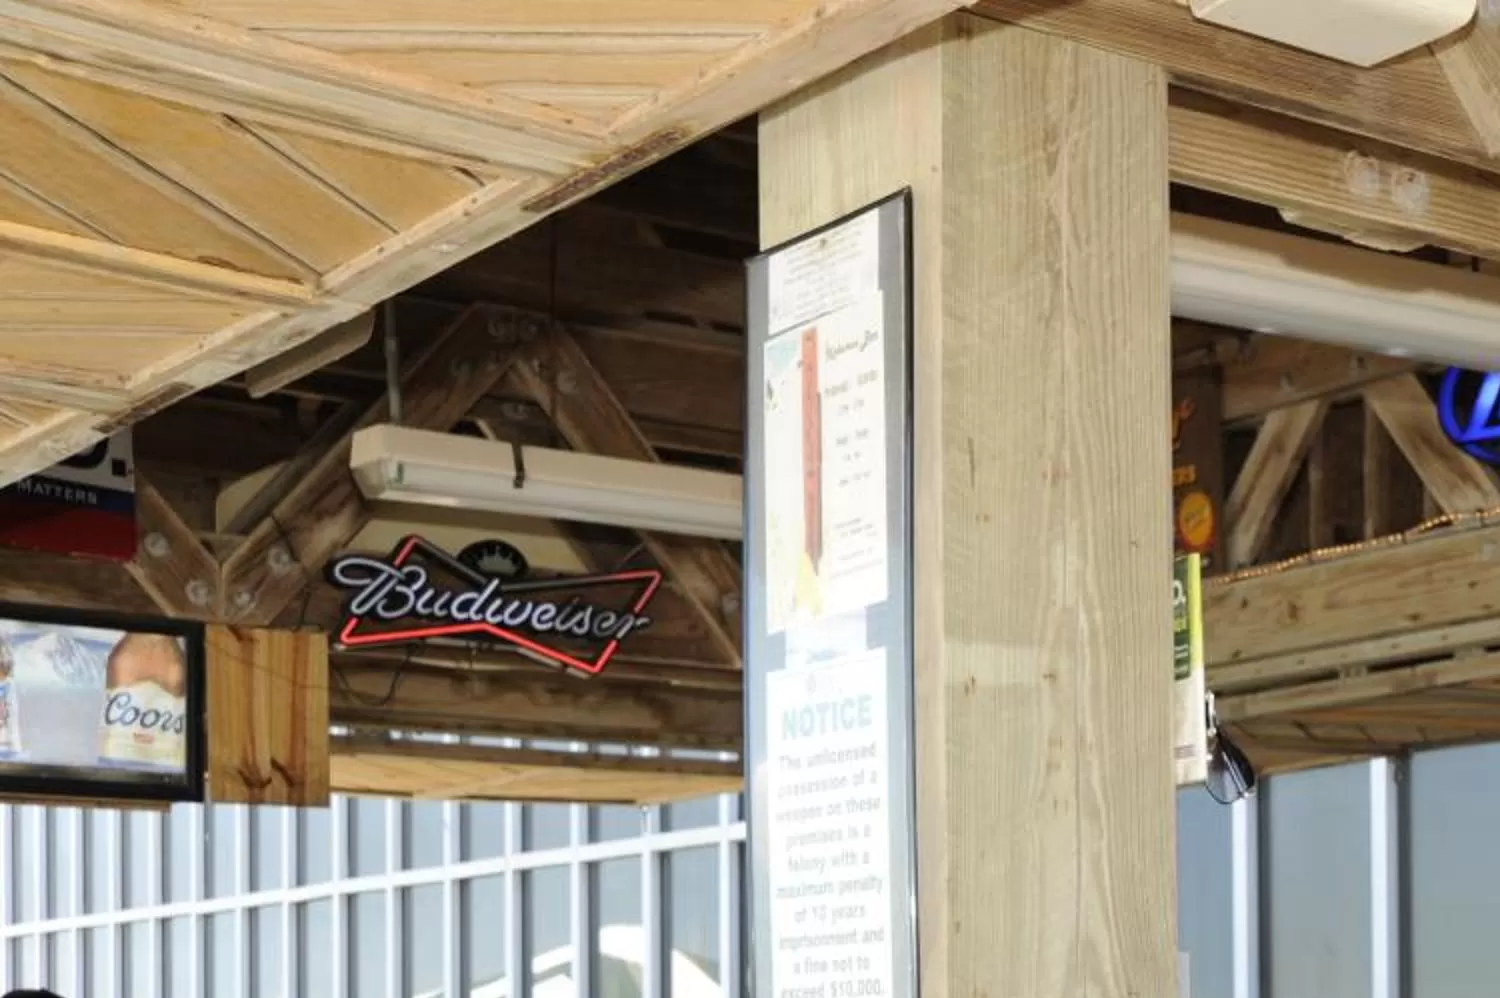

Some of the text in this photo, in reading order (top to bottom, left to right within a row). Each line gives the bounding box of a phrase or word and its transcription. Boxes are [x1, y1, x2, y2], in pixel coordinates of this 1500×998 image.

[17, 478, 98, 505] MATTERS
[333, 556, 649, 640] Budweiser
[105, 691, 186, 735] Coors
[782, 693, 873, 740] NOTICE
[778, 754, 801, 769] The
[804, 956, 828, 974] fine
